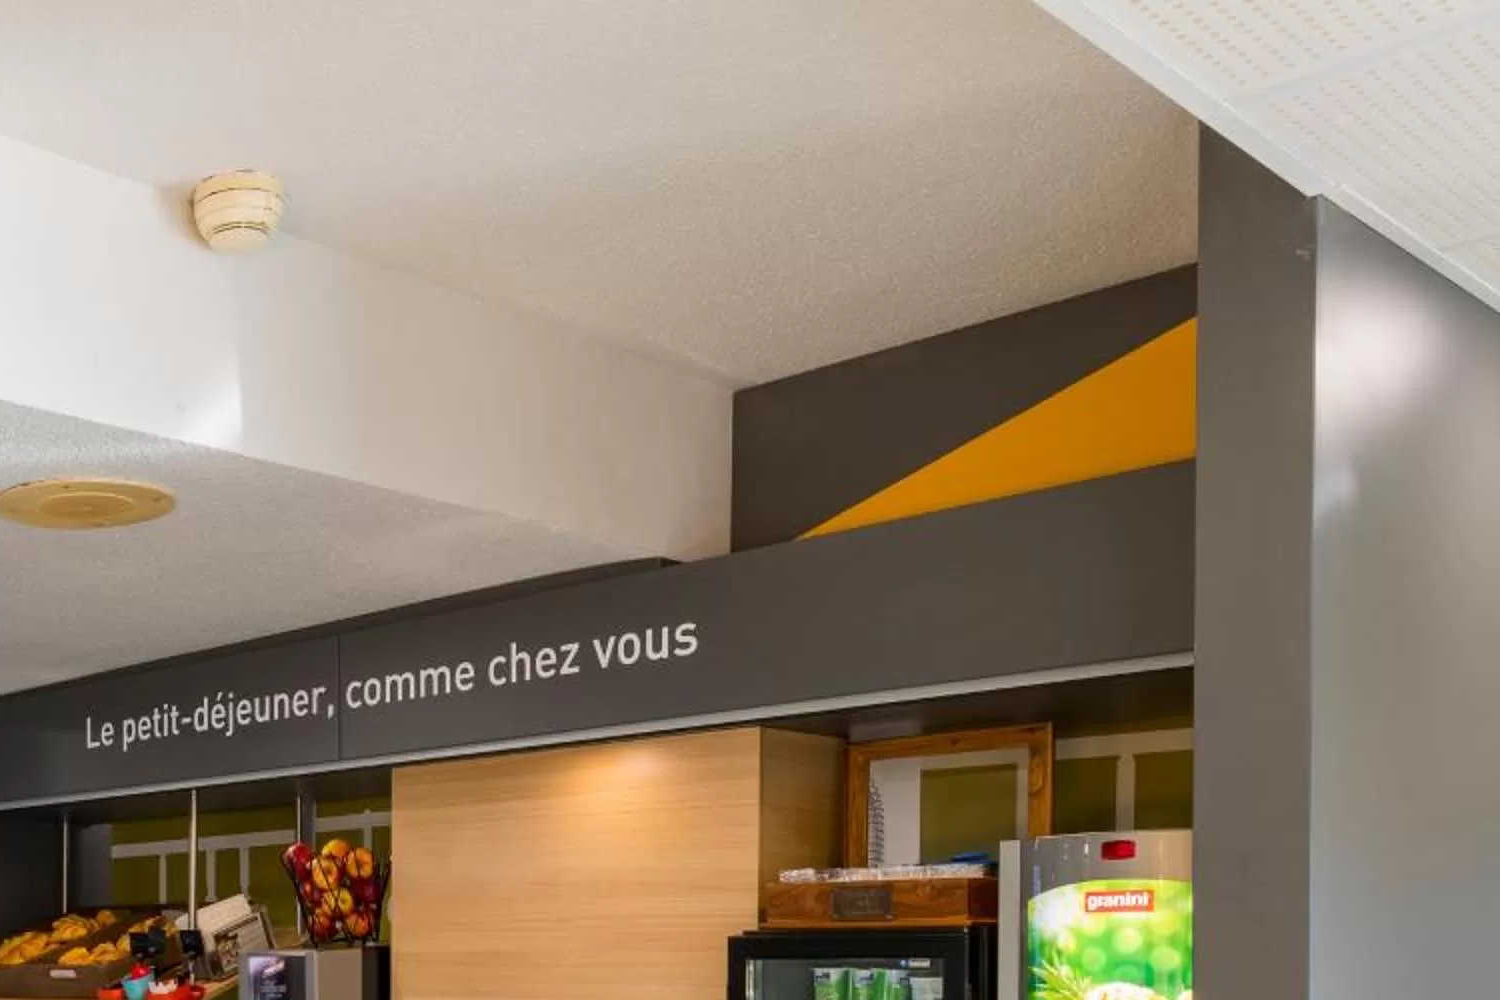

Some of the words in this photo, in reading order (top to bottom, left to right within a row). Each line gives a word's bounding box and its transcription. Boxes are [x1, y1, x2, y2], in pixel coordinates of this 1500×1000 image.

[85, 715, 114, 750] Le
[122, 682, 336, 752] petit-déjeuner,
[345, 661, 475, 710] comme
[488, 641, 581, 686] chez
[591, 621, 699, 670] vous
[1087, 891, 1149, 912] granini
